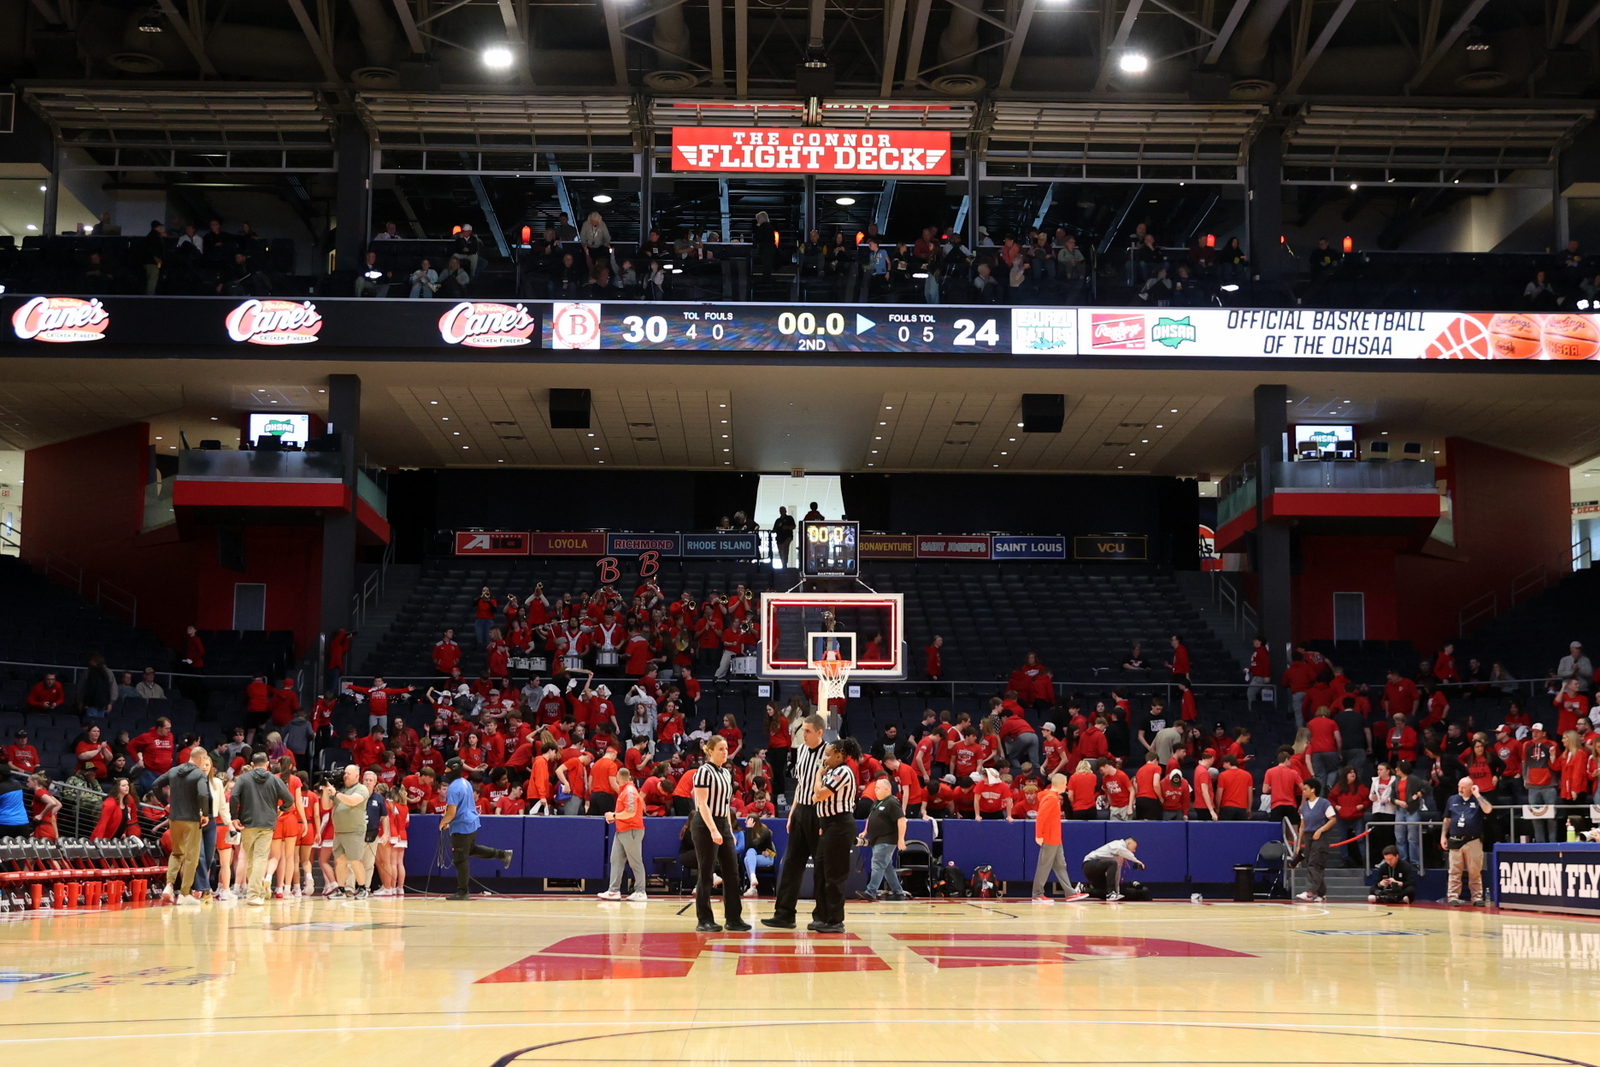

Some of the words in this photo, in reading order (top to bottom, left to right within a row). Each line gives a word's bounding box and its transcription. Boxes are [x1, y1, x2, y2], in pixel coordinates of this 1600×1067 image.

[733, 132, 779, 145] THE
[792, 133, 891, 147] CONNOR
[698, 145, 825, 169] FLIGHT
[834, 147, 927, 171] DECK
[15, 297, 109, 339] Cane's
[229, 299, 322, 341] Cane's
[442, 302, 534, 344] Cane's
[683, 312, 700, 320] TOL
[704, 312, 733, 320] FOULS
[778, 312, 845, 335] 00.0
[889, 314, 917, 323] FOULS
[919, 314, 936, 323] TOL
[1227, 310, 1305, 330] OFFICIAL
[1312, 311, 1426, 331] BASKETBALL
[569, 314, 588, 335] B
[622, 315, 668, 343] 30
[686, 324, 697, 340] 4
[712, 324, 724, 340] 0
[953, 319, 1000, 346] 24
[1153, 324, 1196, 340] OHSAA
[898, 326, 910, 342] 0
[922, 326, 934, 342] 5
[798, 339, 826, 351] 2ND
[1263, 335, 1286, 354] OF
[1294, 336, 1326, 355] THE
[1332, 336, 1392, 355] OHSAA
[548, 539, 588, 549] LOYOLA
[613, 540, 674, 550] RICHMOND
[687, 541, 716, 550] RHODE
[720, 541, 752, 550] ISLAND
[860, 542, 912, 551] BONAVENTURE
[920, 542, 946, 552] SAINT
[995, 543, 1027, 552] SAINT
[1031, 543, 1063, 552] LOUIS
[1097, 543, 1125, 553] VCU
[596, 556, 620, 583] B
[639, 550, 660, 577] B
[1499, 861, 1562, 897] DAYTON
[1565, 864, 1600, 898] FLY
